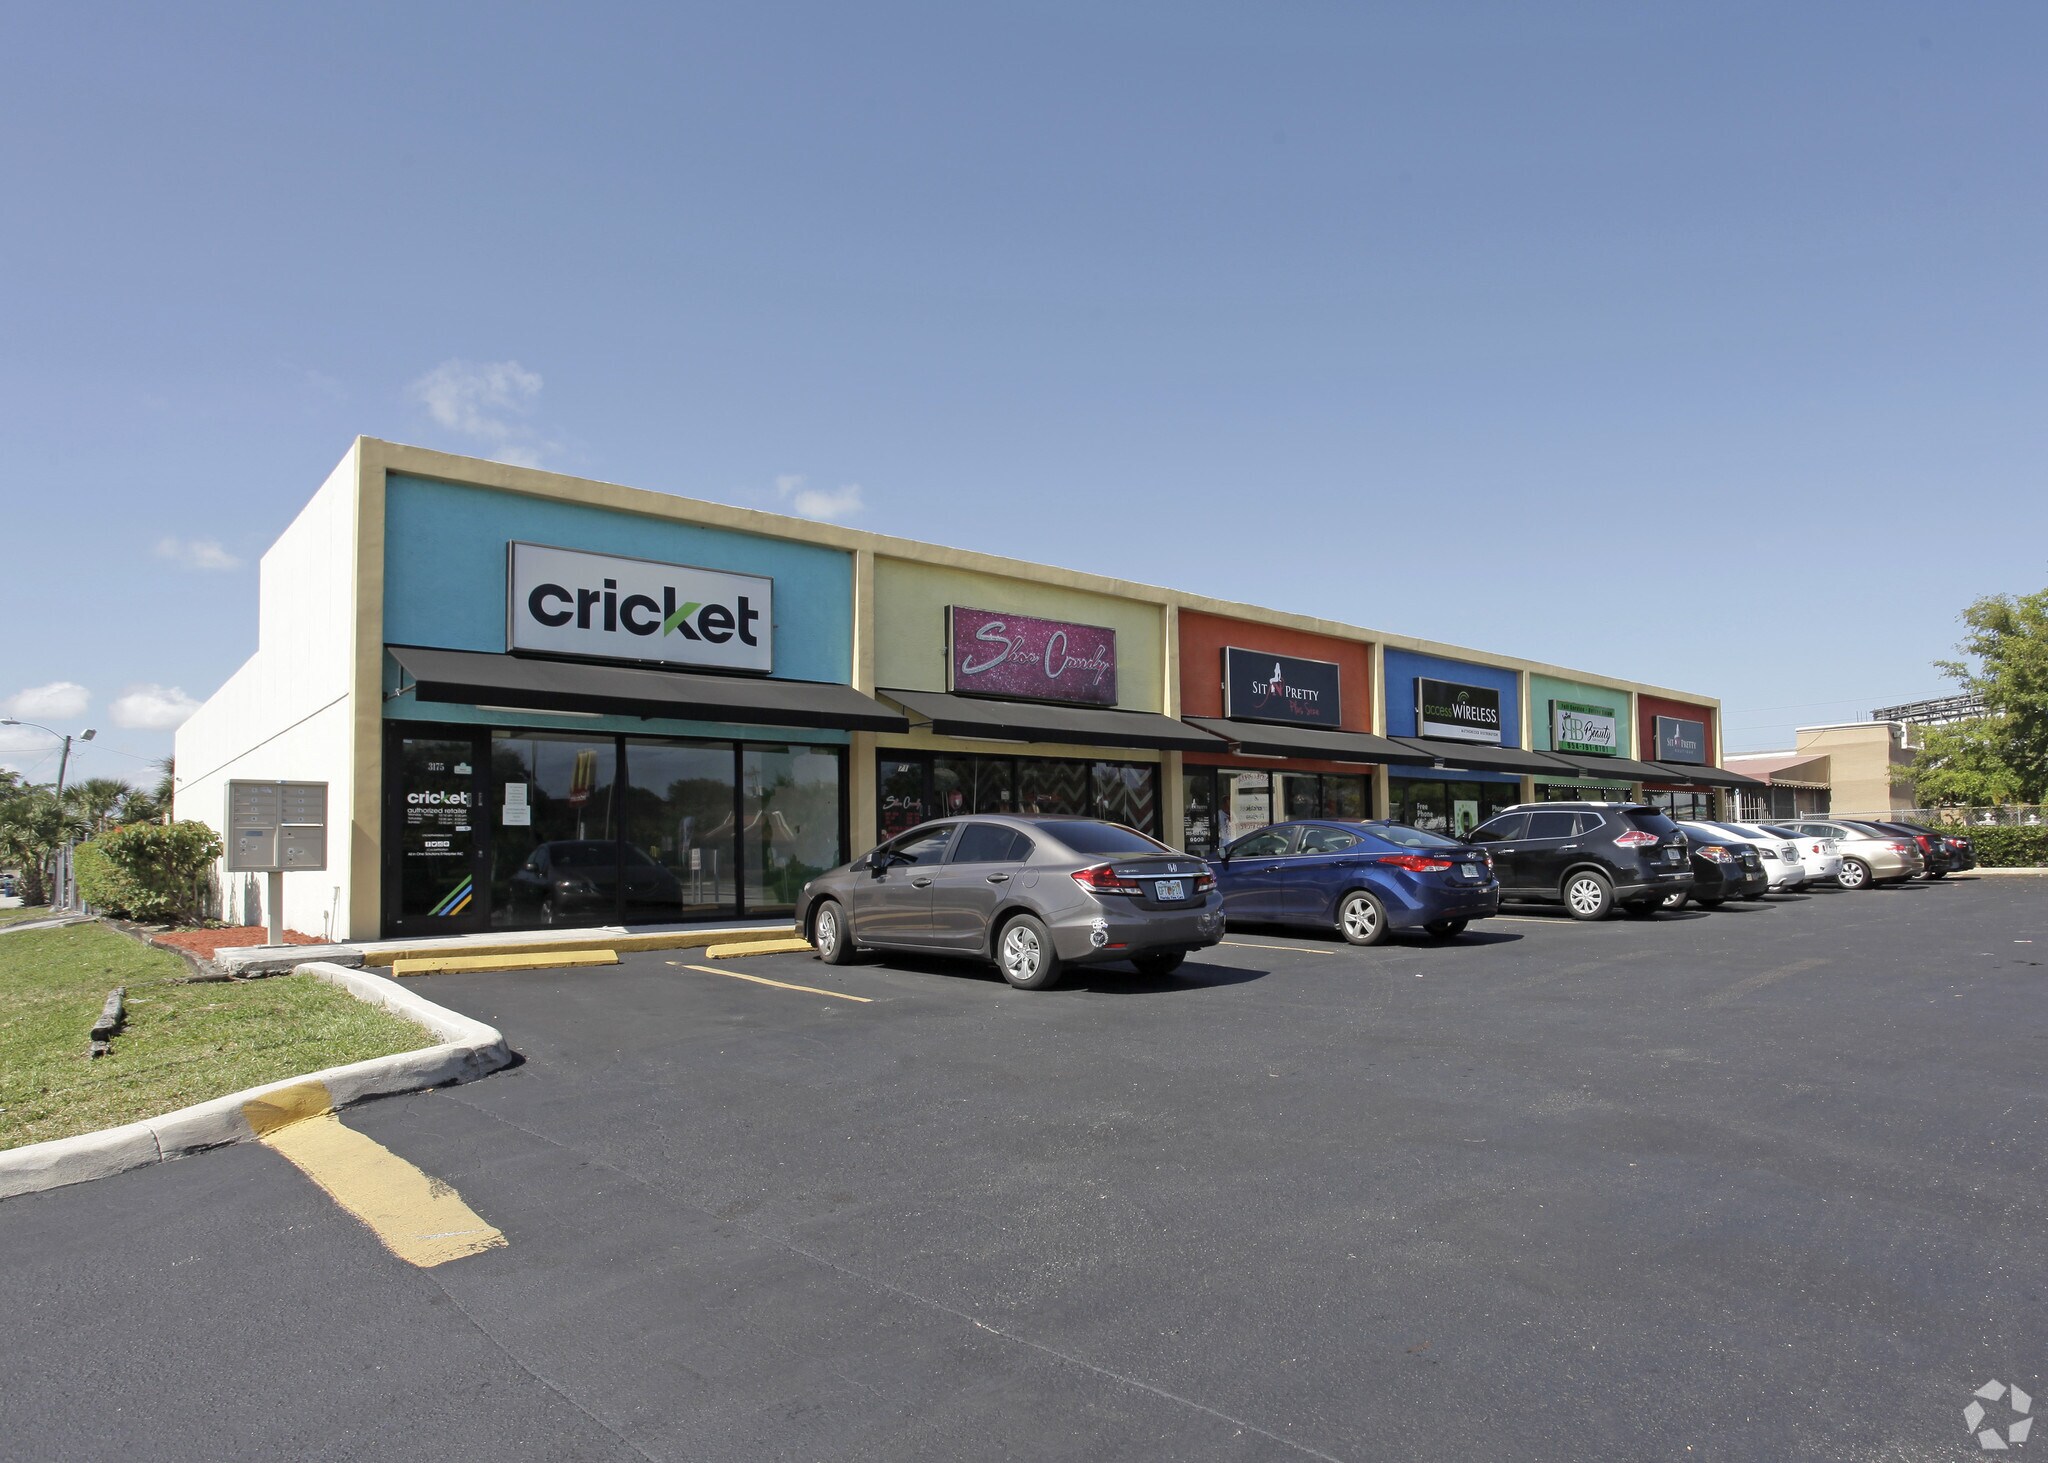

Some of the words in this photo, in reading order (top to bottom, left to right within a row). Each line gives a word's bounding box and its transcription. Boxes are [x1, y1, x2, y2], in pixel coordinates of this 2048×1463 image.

[528, 578, 759, 647] cricket
[961, 621, 1040, 675] Shoe
[1044, 630, 1110, 686] Candy
[1285, 685, 1319, 701] PRETTY
[1583, 720, 1611, 745] Beauty
[427, 762, 445, 771] 3175
[407, 790, 468, 805] cricket
[1416, 802, 1429, 810] Free
[1416, 810, 1434, 818] Phone
